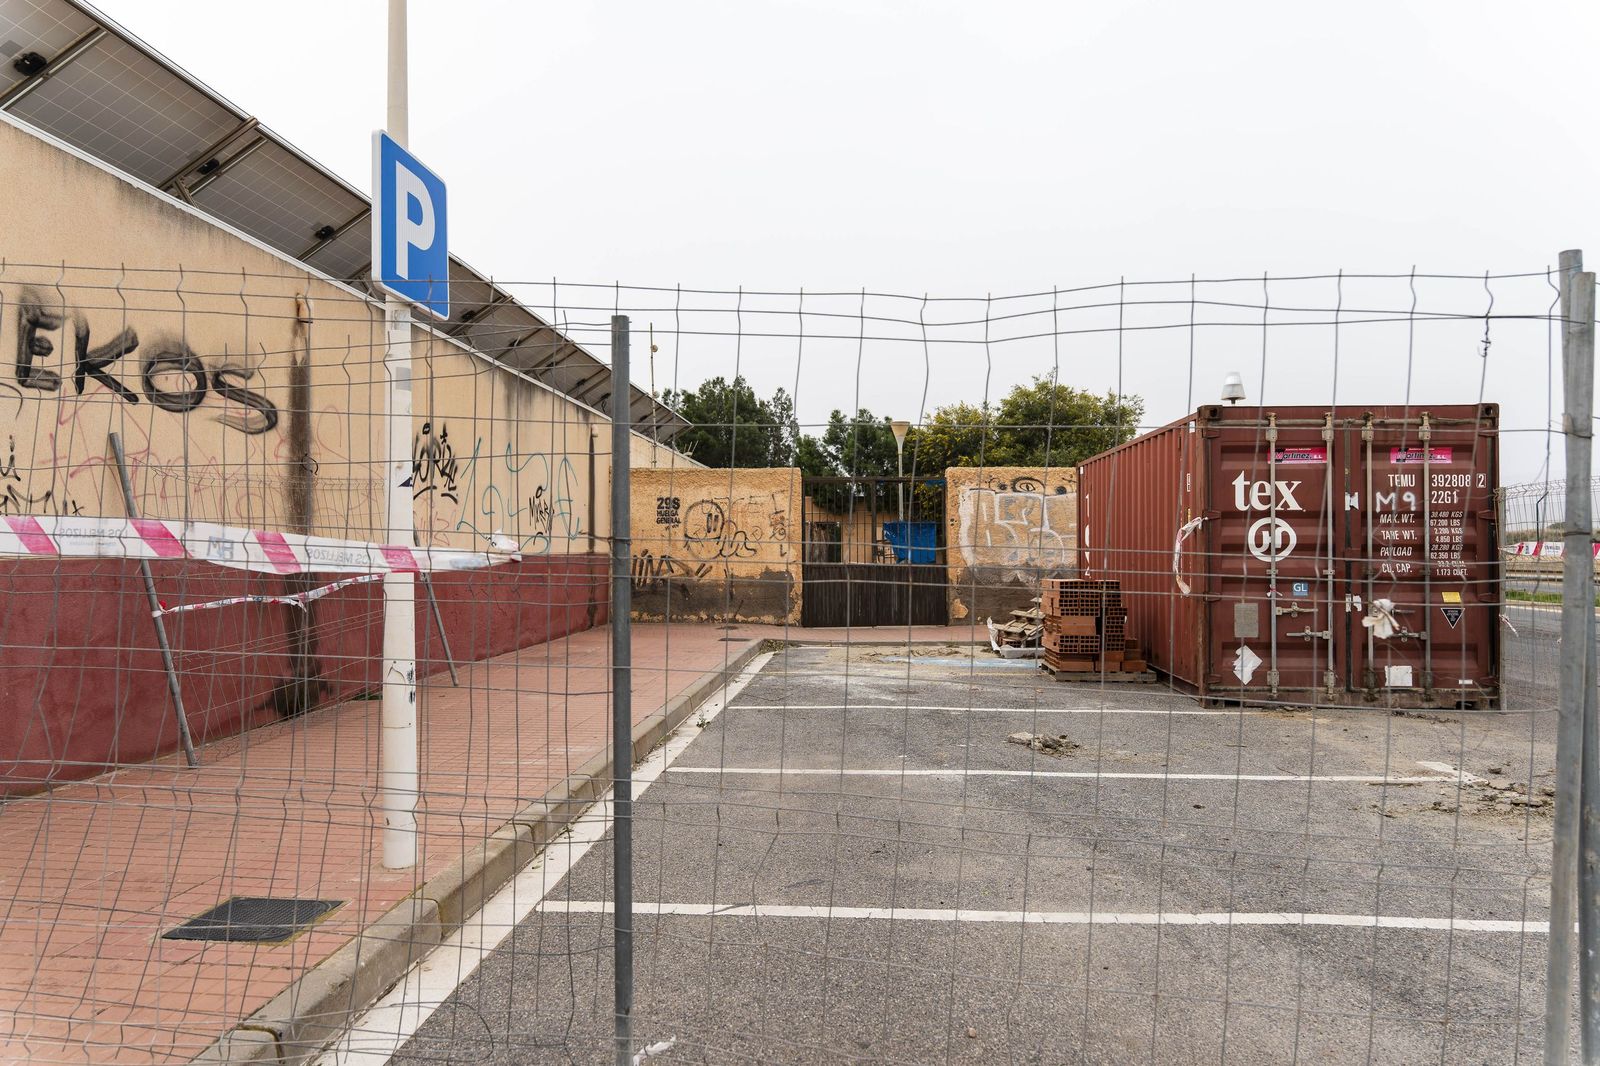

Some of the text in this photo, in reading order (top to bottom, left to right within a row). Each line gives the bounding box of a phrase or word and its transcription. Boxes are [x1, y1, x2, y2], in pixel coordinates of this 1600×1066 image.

[396, 160, 436, 280] P
[15, 284, 279, 435] EKOS
[1388, 474, 1486, 488] TEMU 392808 2
[1431, 490, 1459, 504] 22G1
[656, 497, 681, 510] 29S
[1401, 513, 1416, 524] WT.
[1381, 530, 1400, 540] TARE
[1402, 530, 1418, 540] WT.
[1452, 535, 1463, 543] LBS
[1380, 546, 1413, 557] PAYLOAD
[1381, 563, 1395, 574] CU.
[1396, 563, 1413, 574] CAP.
[1293, 582, 1308, 592] GL
